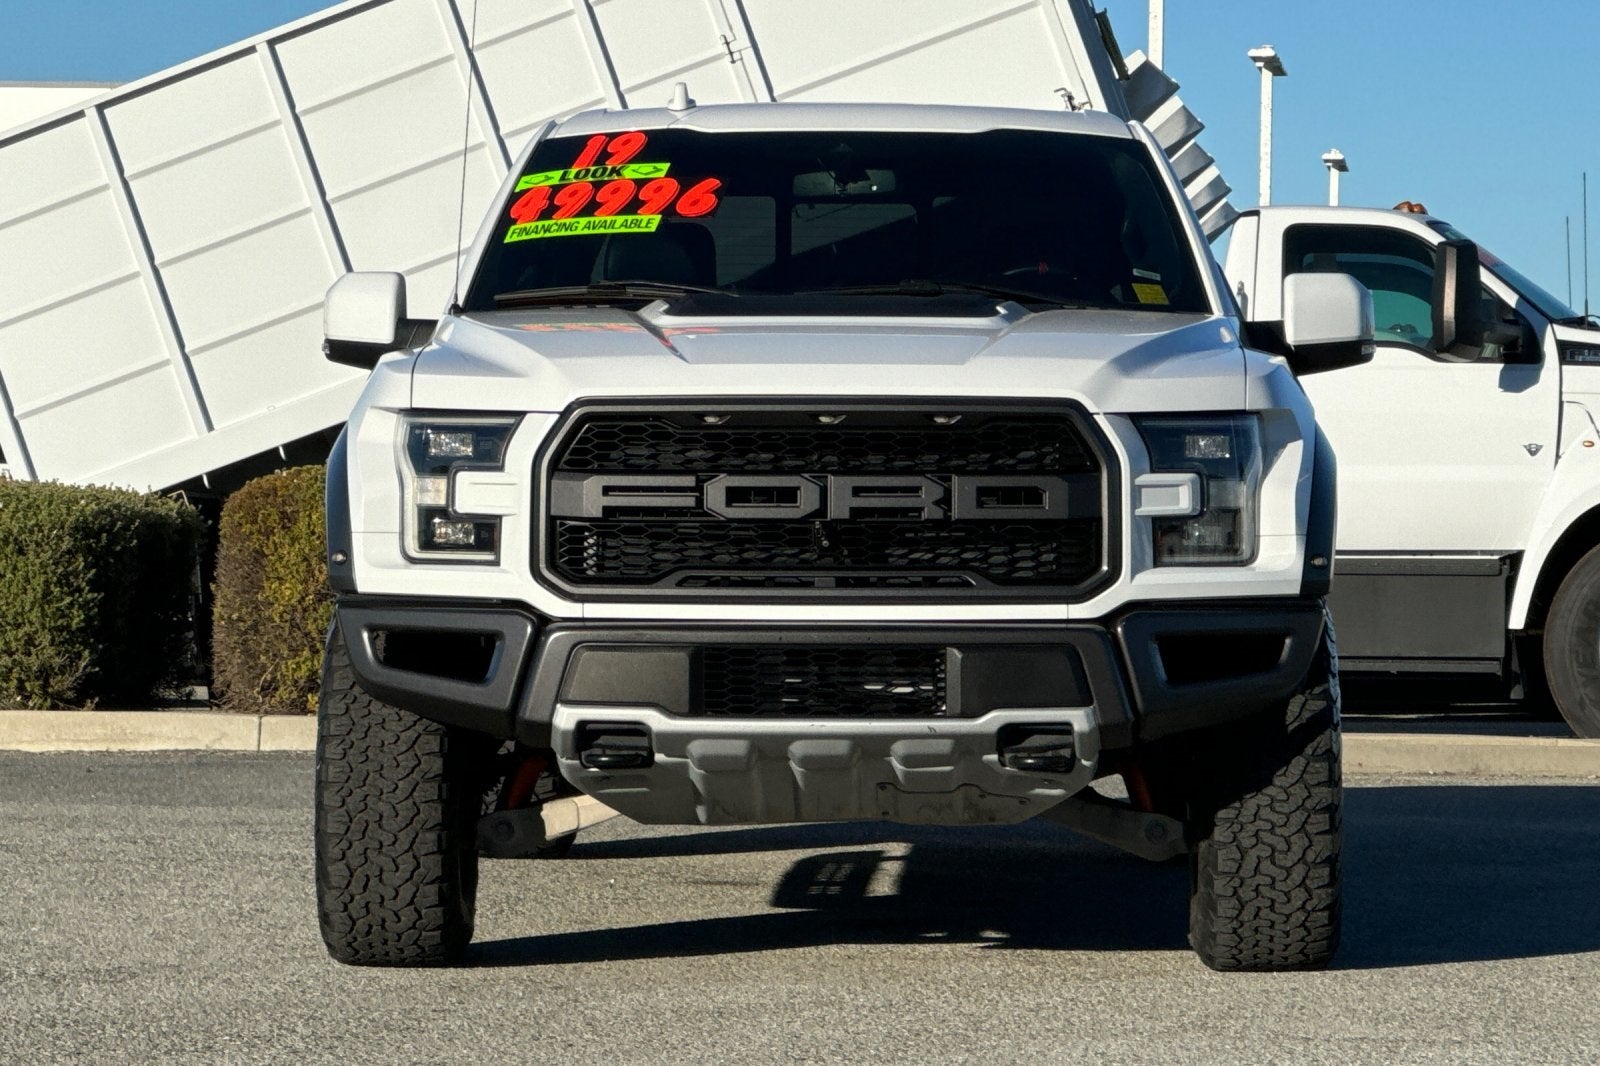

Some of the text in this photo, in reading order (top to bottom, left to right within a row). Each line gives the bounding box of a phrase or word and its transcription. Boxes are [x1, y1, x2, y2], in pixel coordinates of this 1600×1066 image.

[572, 130, 648, 168] 19
[559, 165, 628, 181] LOOK
[510, 177, 722, 224] 49996
[509, 217, 656, 239] FINANCING AVAILABLE
[576, 474, 1069, 520] FORD
